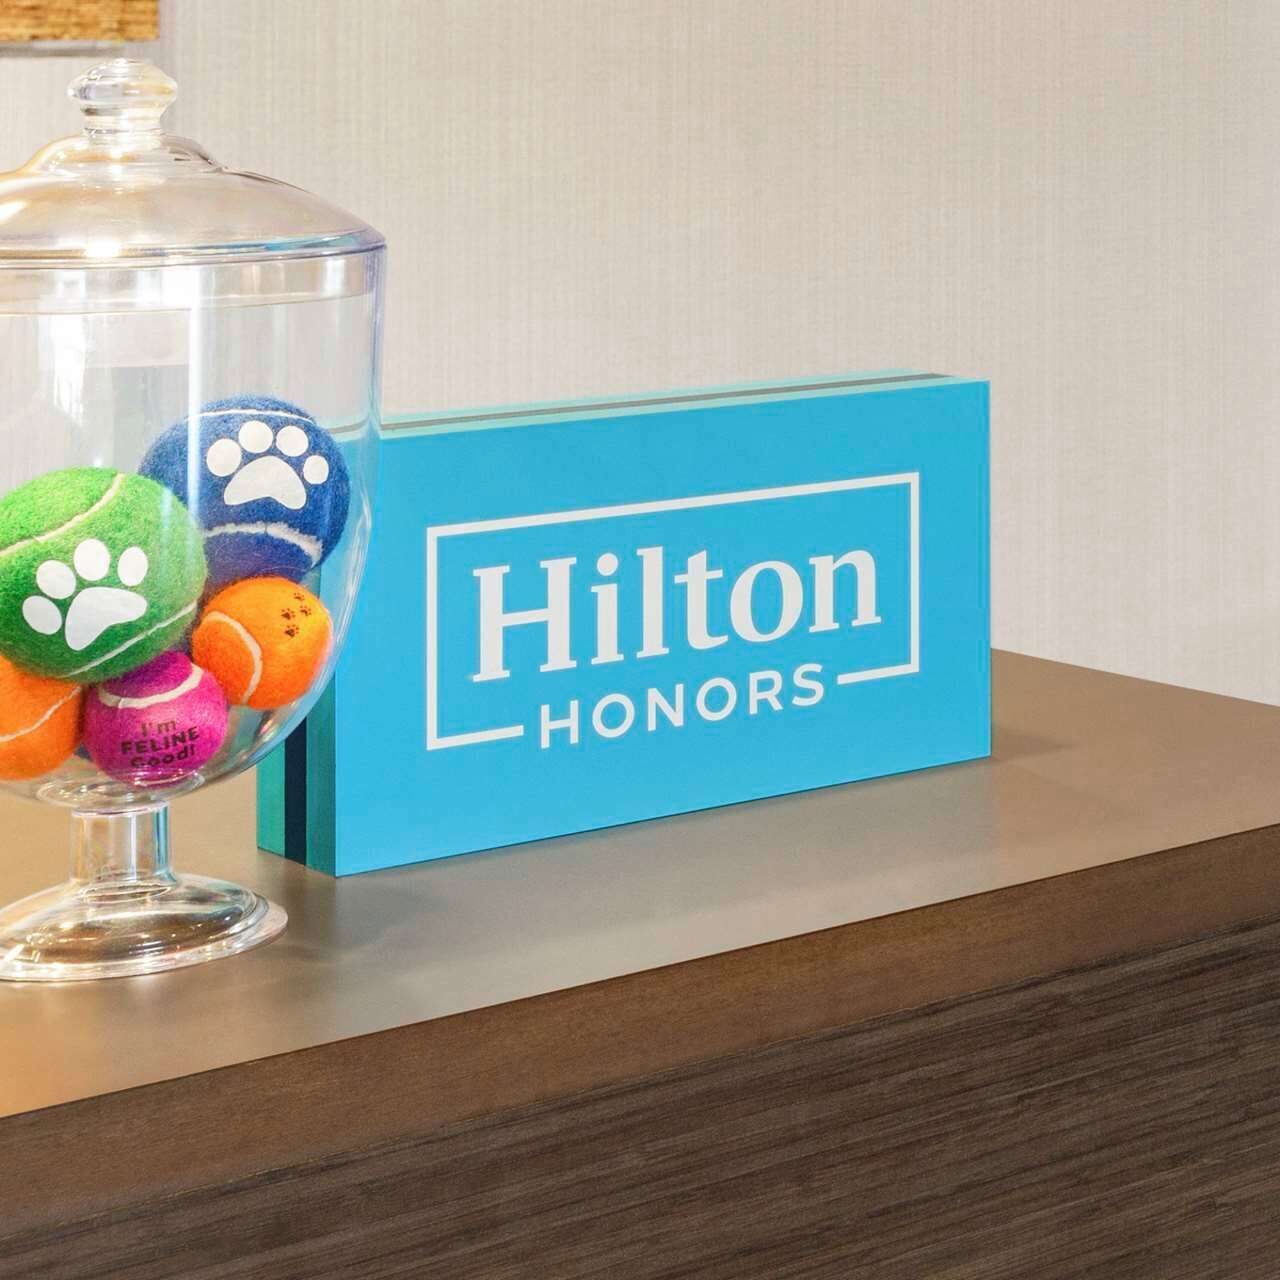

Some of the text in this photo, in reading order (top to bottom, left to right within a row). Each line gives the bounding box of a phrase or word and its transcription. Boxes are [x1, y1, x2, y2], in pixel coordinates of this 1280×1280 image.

[471, 545, 883, 683] Hilton
[140, 719, 177, 738] I'm
[539, 663, 827, 749] HONORS
[119, 725, 201, 755] FELINE
